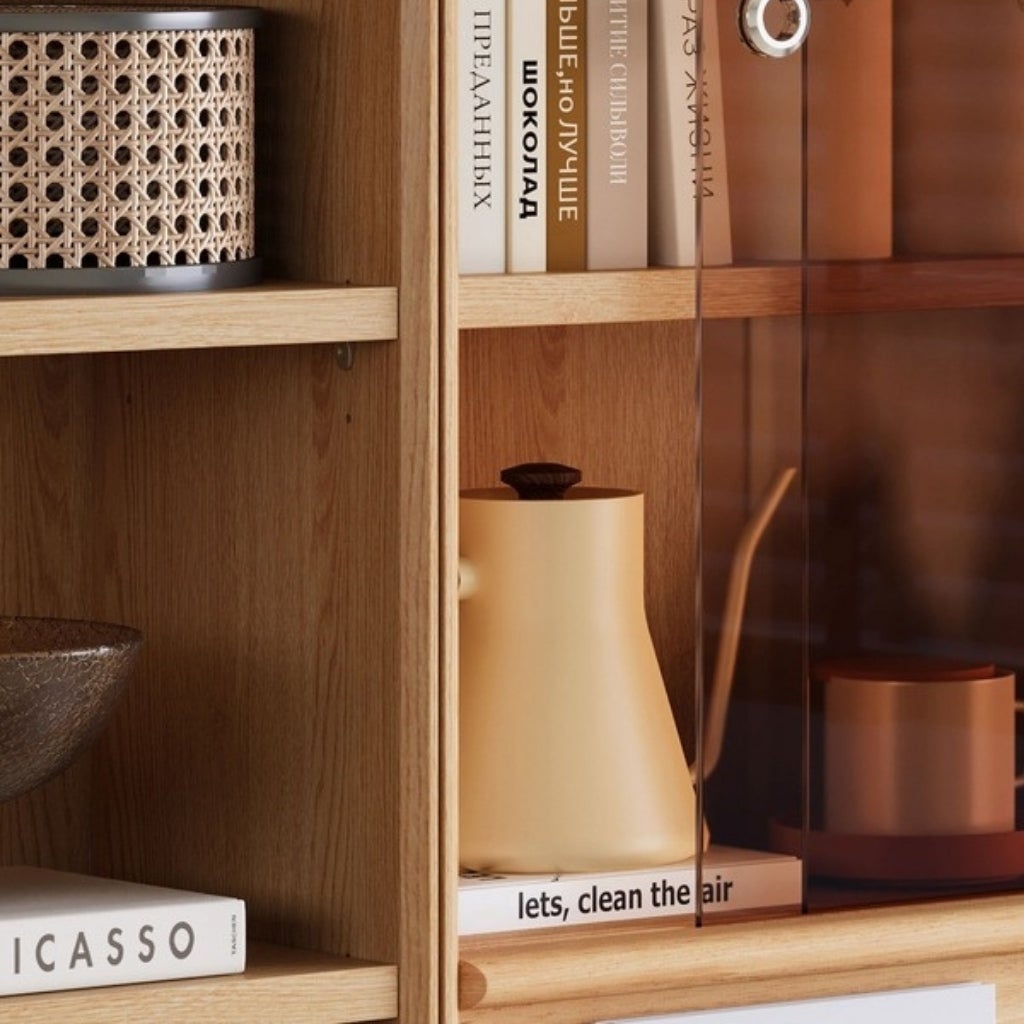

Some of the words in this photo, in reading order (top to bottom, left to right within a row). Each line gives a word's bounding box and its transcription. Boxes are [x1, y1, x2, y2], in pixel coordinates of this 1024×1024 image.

[472, 10, 495, 210] ПРЕДАННЫХ
[519, 60, 540, 221] ШОКОЛАД
[558, 118, 579, 222] ЛУЧШЕ
[684, 65, 715, 201] ЖИЗНИ
[518, 891, 570, 922] lets,
[578, 885, 641, 915] clean
[650, 879, 691, 906] the
[701, 875, 733, 904] air
